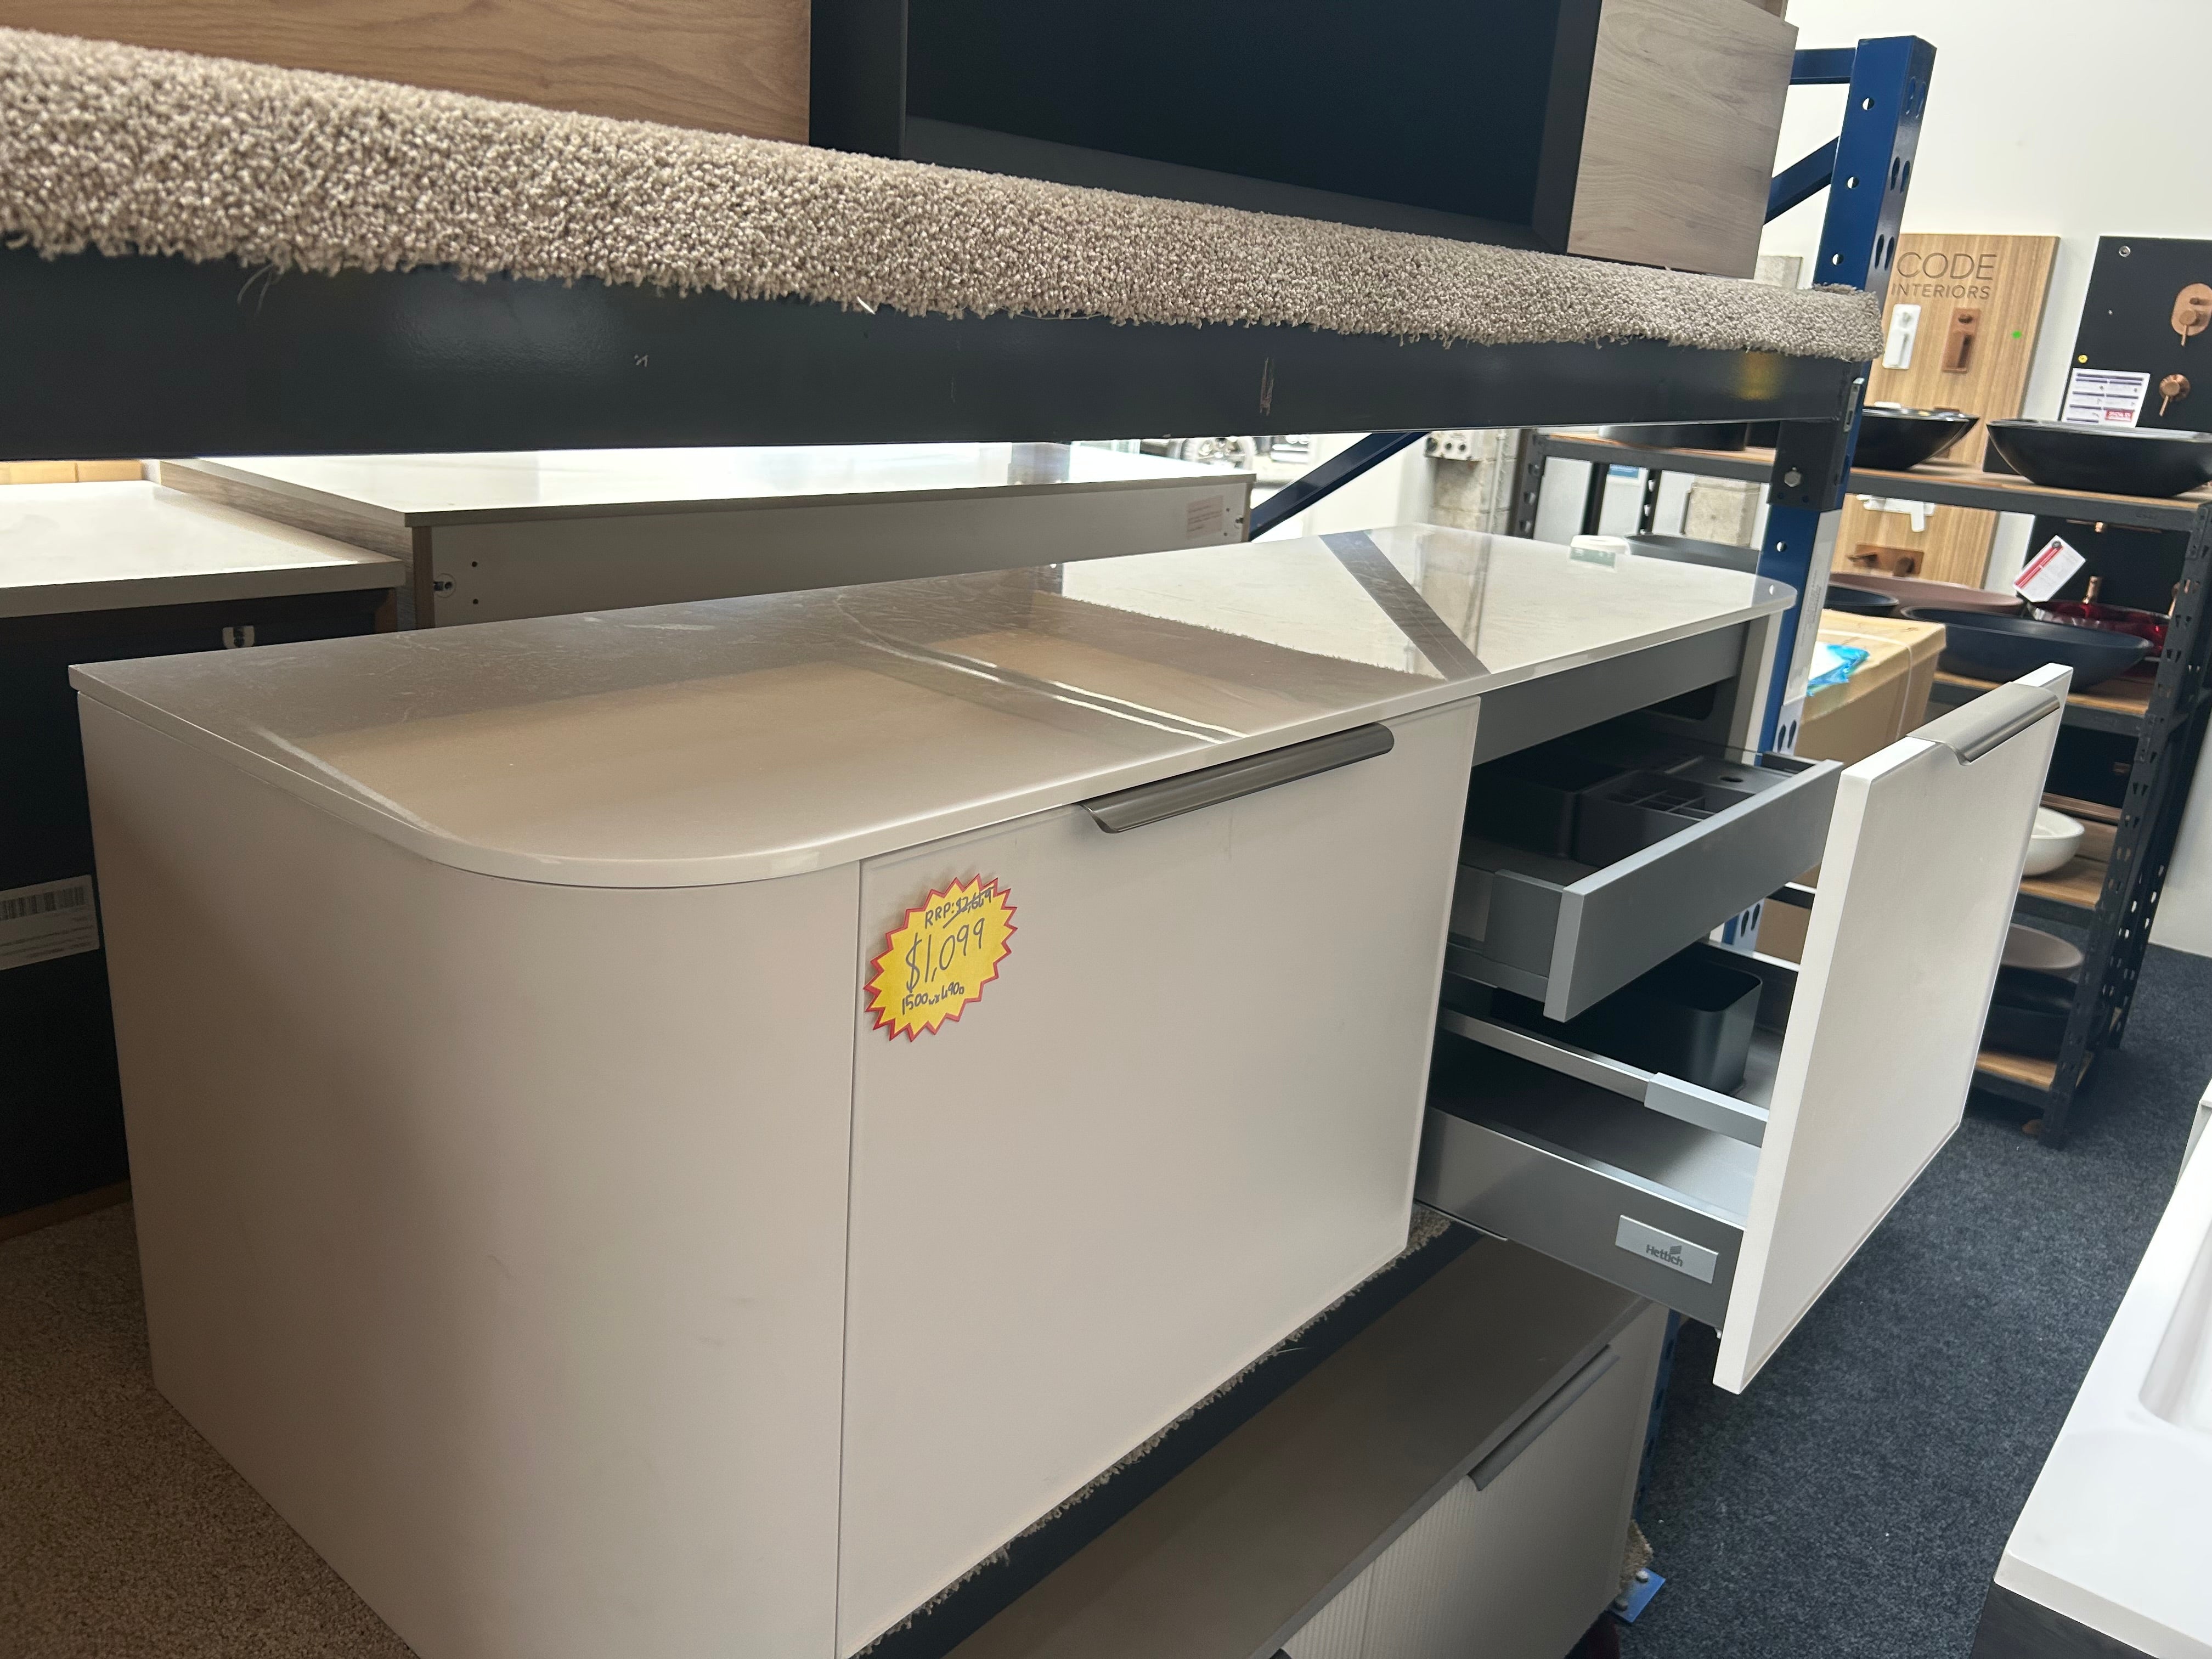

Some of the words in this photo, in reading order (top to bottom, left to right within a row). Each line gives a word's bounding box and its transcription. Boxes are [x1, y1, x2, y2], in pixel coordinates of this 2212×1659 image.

[1897, 251, 1997, 280] CODE
[1891, 283, 1991, 300] INTERIORS
[905, 917, 985, 994] $1,099
[1645, 1243, 1684, 1268] Hettich
